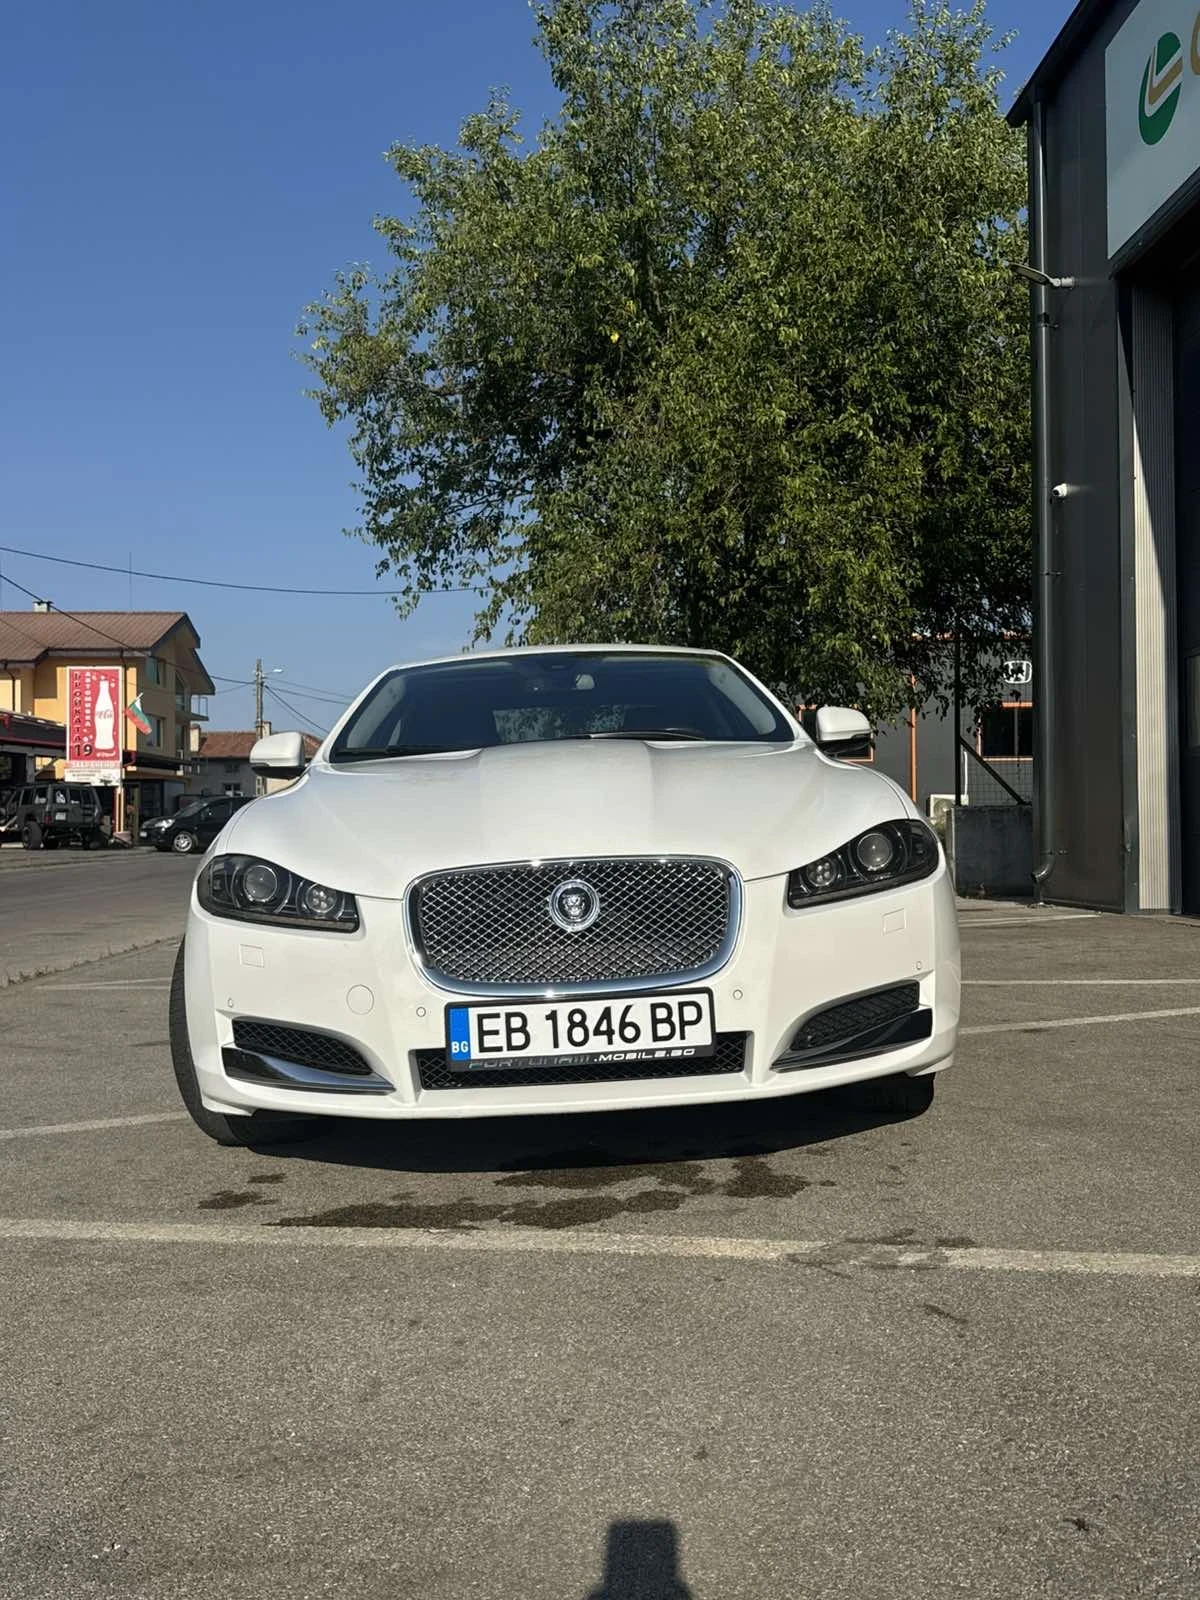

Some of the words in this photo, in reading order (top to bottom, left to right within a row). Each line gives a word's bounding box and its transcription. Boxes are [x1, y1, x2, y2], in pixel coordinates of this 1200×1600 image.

[74, 743, 93, 757] 19
[476, 1010, 532, 1054] EB
[545, 1004, 642, 1049] 1846
[650, 1000, 704, 1043] BP
[451, 1041, 470, 1054] BG
